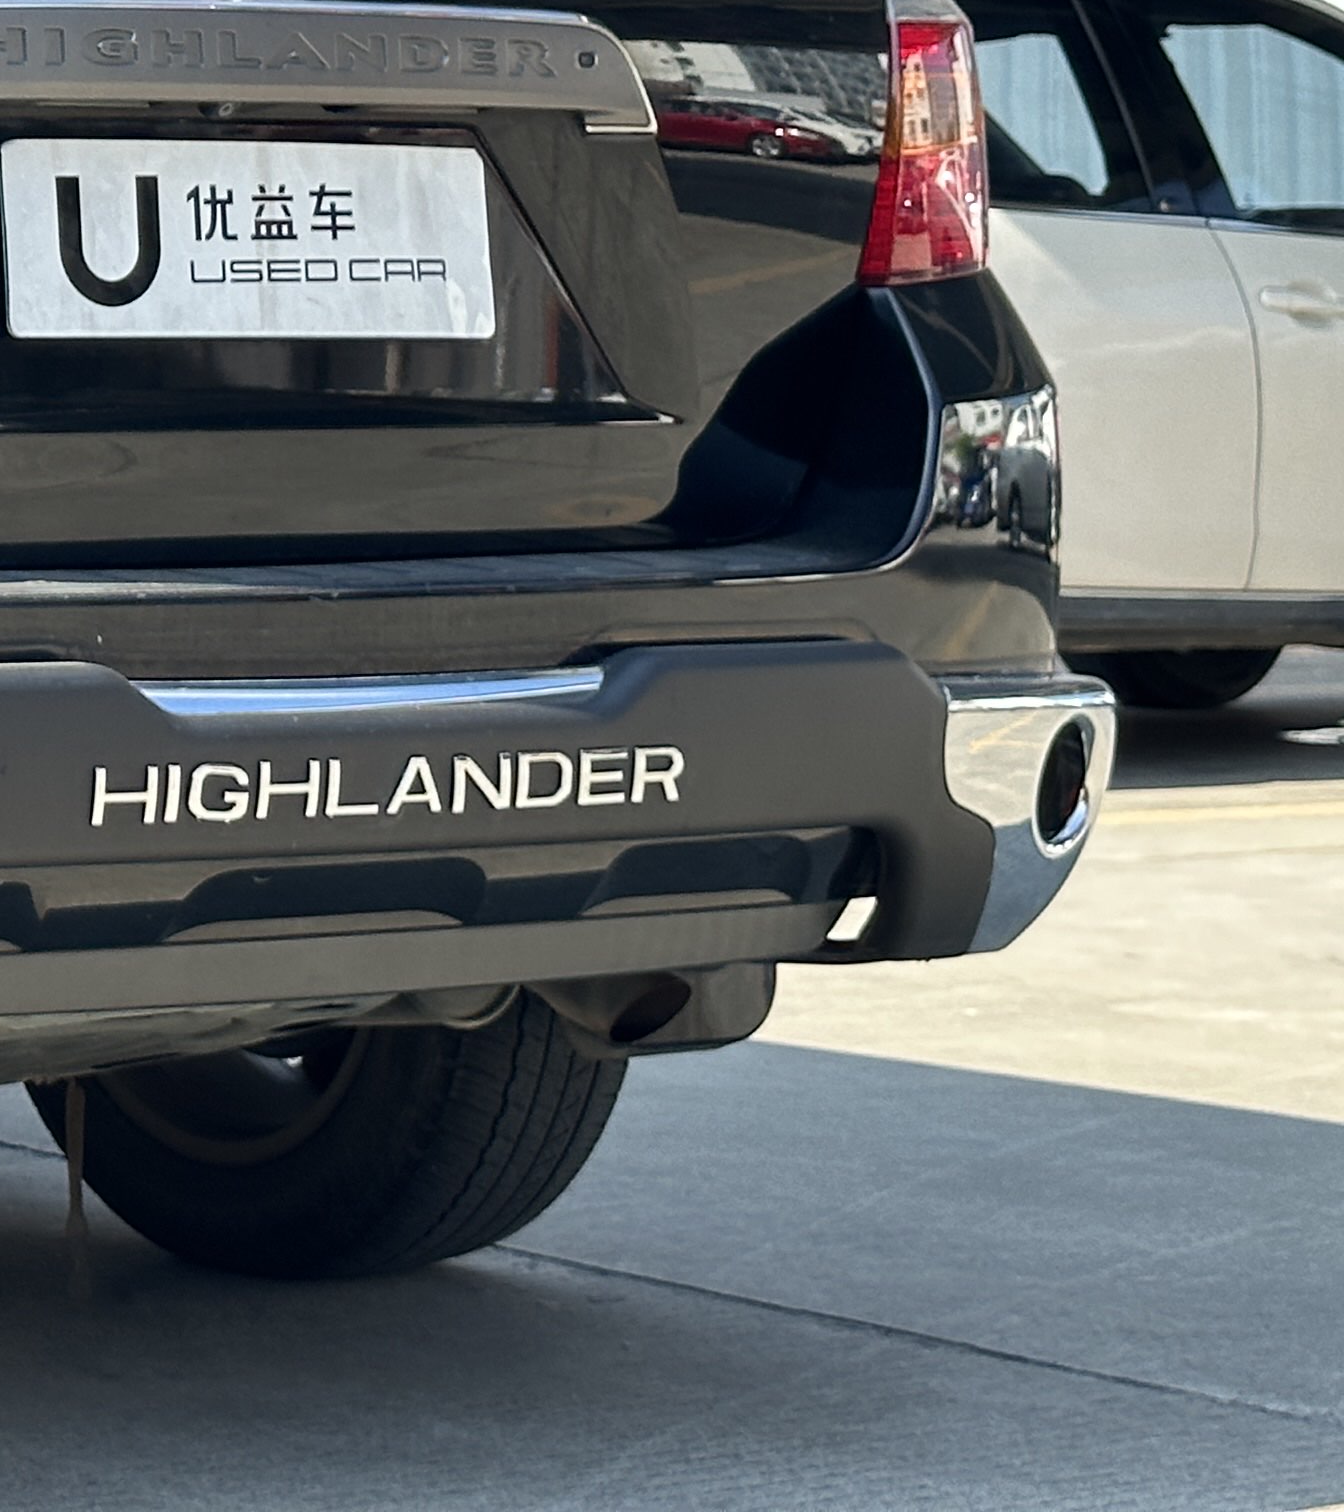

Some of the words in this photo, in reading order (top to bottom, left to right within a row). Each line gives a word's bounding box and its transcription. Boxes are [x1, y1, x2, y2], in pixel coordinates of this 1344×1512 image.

[55, 175, 161, 307] U
[186, 183, 356, 242] 优益车
[190, 259, 338, 283] USED
[348, 259, 446, 283] CAR
[90, 745, 686, 826] HIGHLANDER
